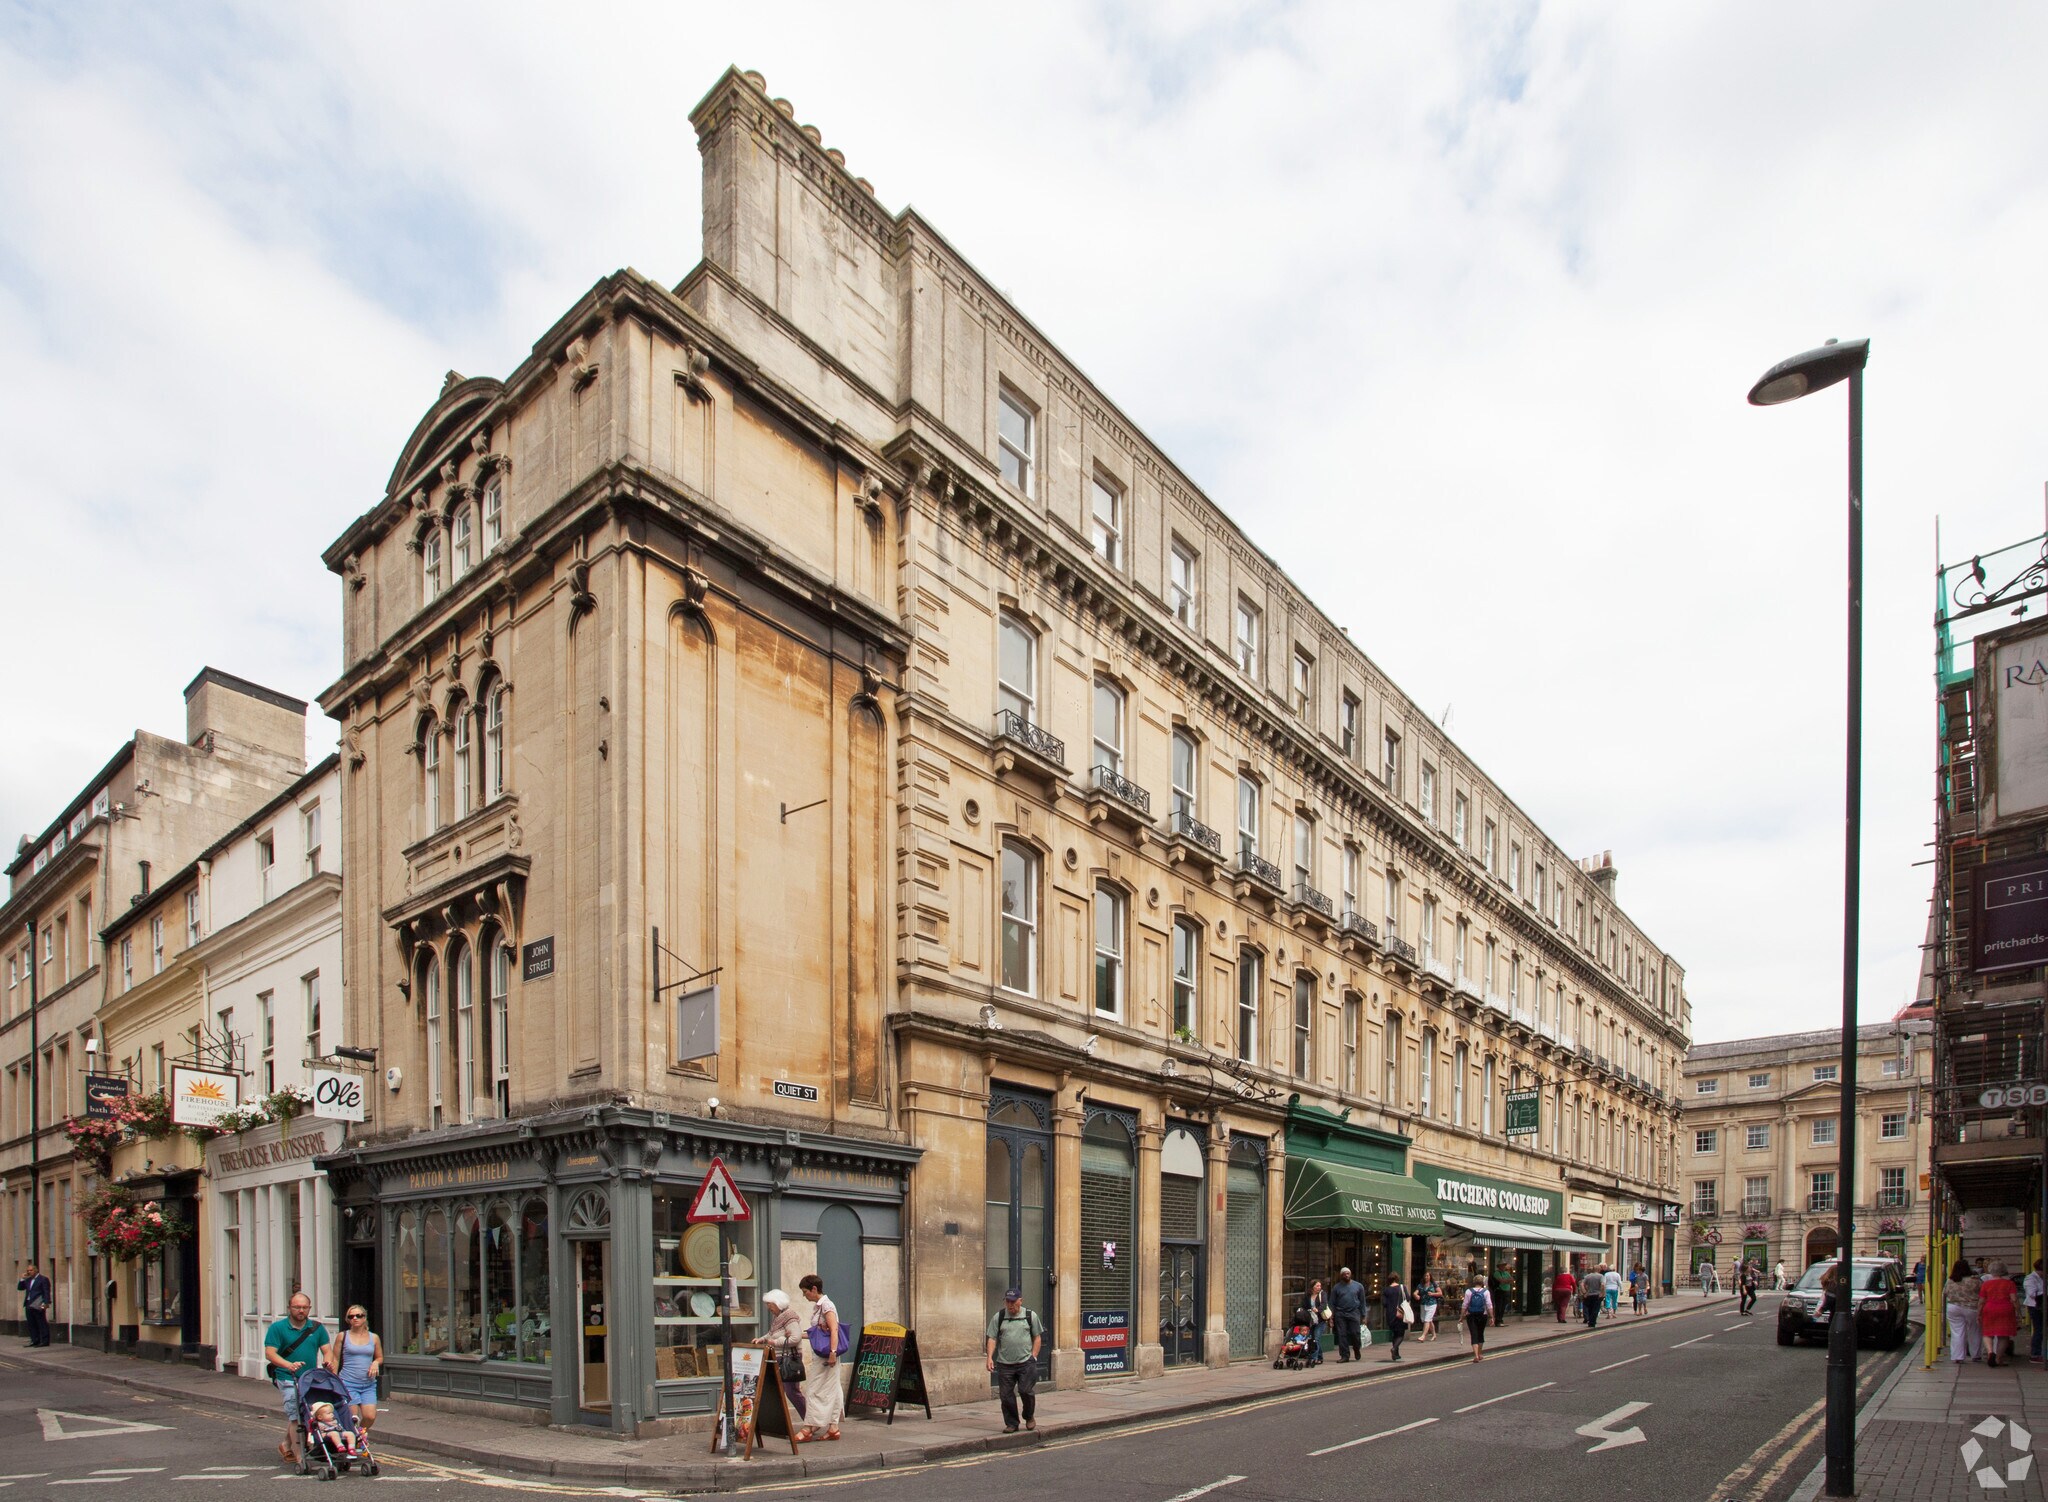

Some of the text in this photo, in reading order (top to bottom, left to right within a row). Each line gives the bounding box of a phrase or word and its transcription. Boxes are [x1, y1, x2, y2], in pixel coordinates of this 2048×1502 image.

[2007, 880, 2043, 897] PRI
[531, 943, 549, 958] JOHN
[529, 958, 551, 975] STREET
[89, 1083, 126, 1092] salamander
[316, 1077, 361, 1108] Olé
[777, 1084, 815, 1099] QUIET ST
[181, 1096, 231, 1108] FIREHOUSE
[1507, 1092, 1538, 1102] KITCHENS
[1987, 1088, 2046, 1105] TSB
[90, 1105, 108, 1114] bath
[1507, 1126, 1537, 1136] KITCHENS
[218, 1131, 328, 1173] FIREHOUSE ROTISSERIE
[410, 1161, 509, 1189] PAXTON & WHITFIELD
[792, 1166, 894, 1190] PAXTON & WHITFIELD
[1437, 1178, 1550, 1216] KITCHENS COOKSHOP
[1351, 1199, 1437, 1221] QUIET STREET ANTIQUES
[1088, 1314, 1124, 1325] Carter Jonas
[1086, 1363, 1103, 1371] 01225
